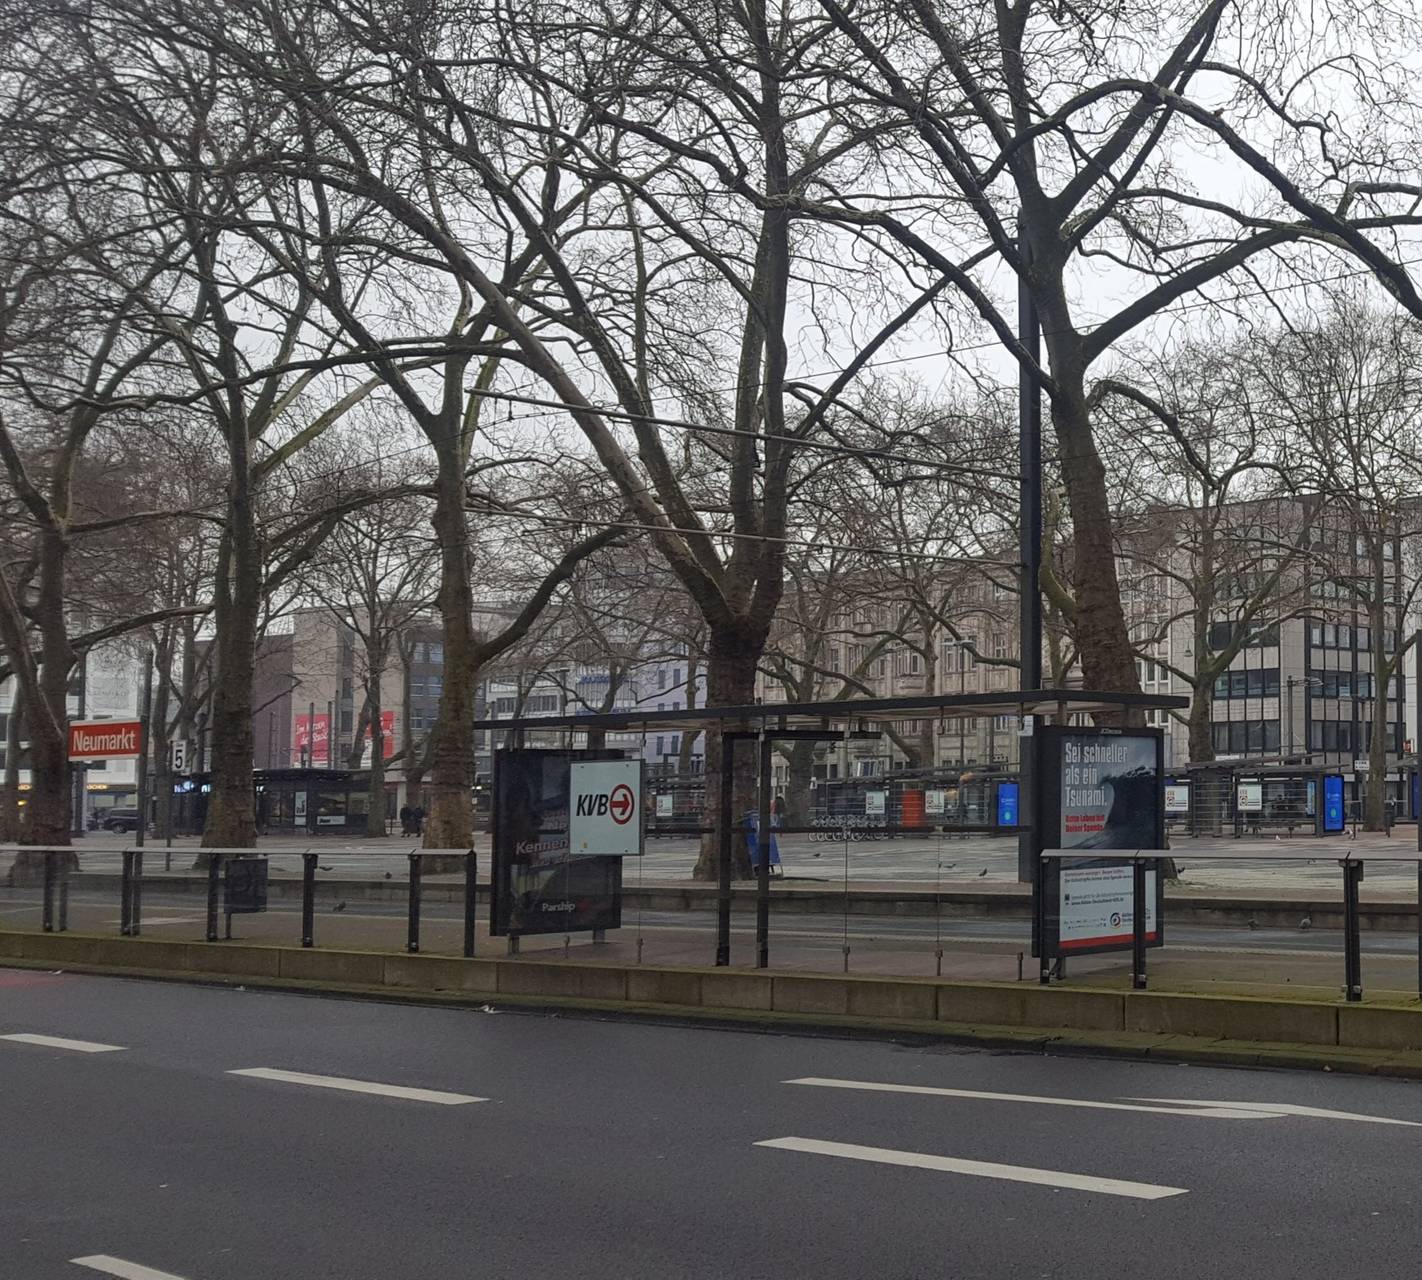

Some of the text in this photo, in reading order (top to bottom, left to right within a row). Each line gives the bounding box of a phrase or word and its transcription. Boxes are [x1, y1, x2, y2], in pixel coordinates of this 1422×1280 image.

[73, 728, 135, 752] Neumarkt
[174, 749, 183, 769] 5
[1065, 742, 1128, 763] Sei schneller
[1065, 764, 1098, 785] als ein
[576, 794, 609, 816] KVB
[1065, 786, 1108, 807] Tsunami.
[541, 901, 576, 913] Parship
